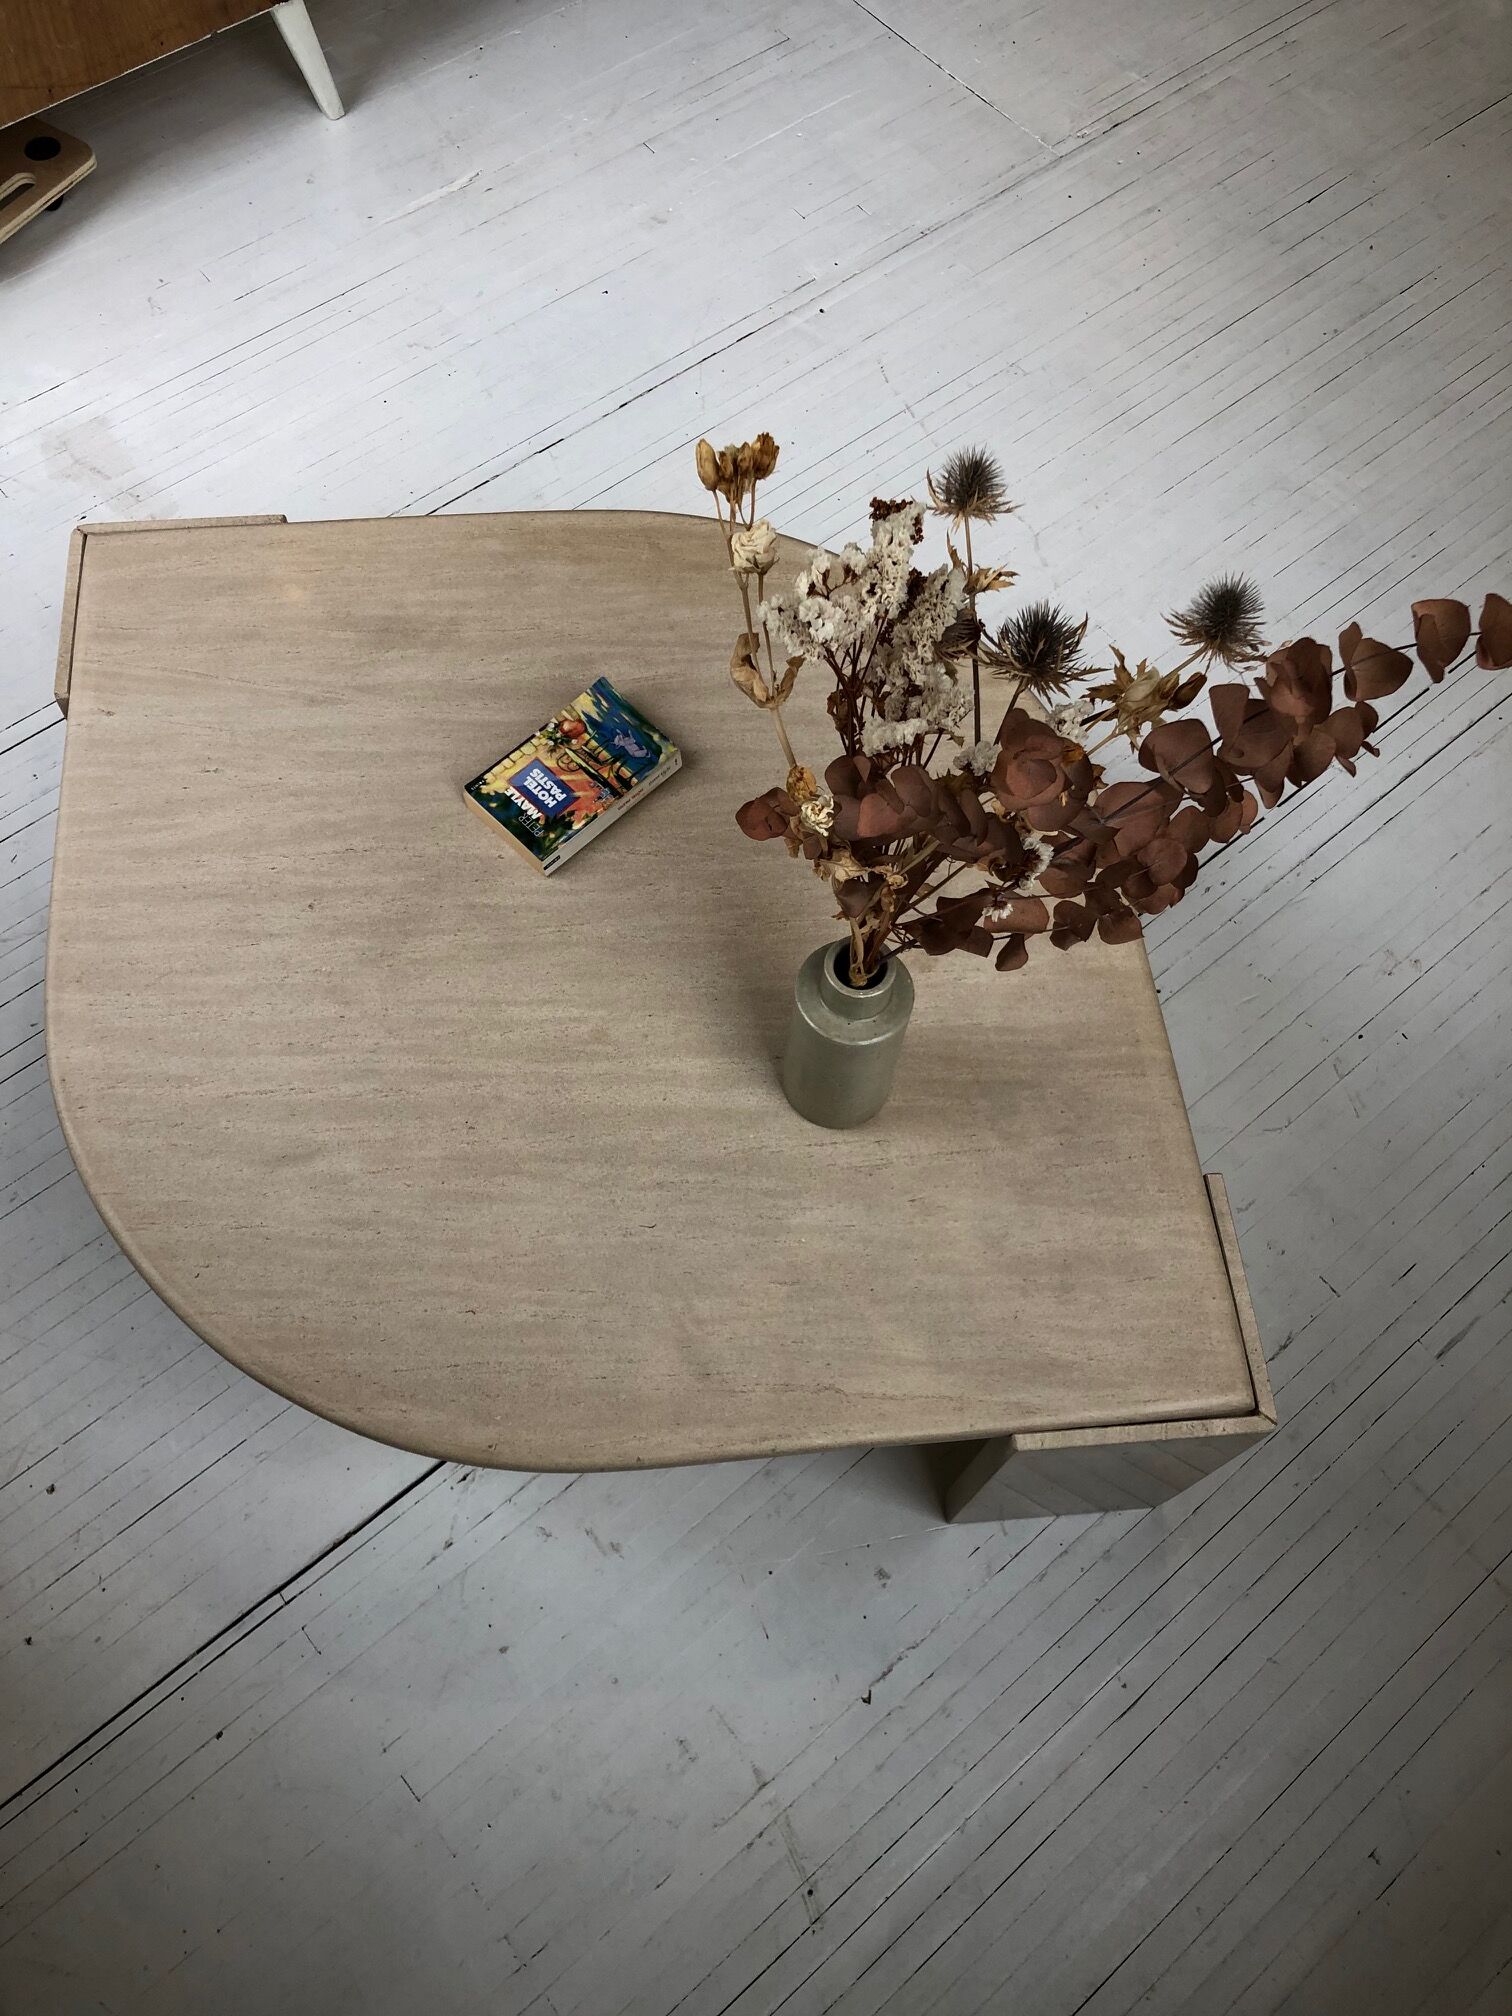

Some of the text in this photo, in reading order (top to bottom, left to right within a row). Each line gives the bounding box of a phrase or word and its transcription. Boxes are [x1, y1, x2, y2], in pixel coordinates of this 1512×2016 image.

[523, 776, 557, 808] HOTEL
[530, 768, 567, 801] PASTIS
[504, 786, 543, 819] MAYLE
[518, 812, 544, 837] PETER
